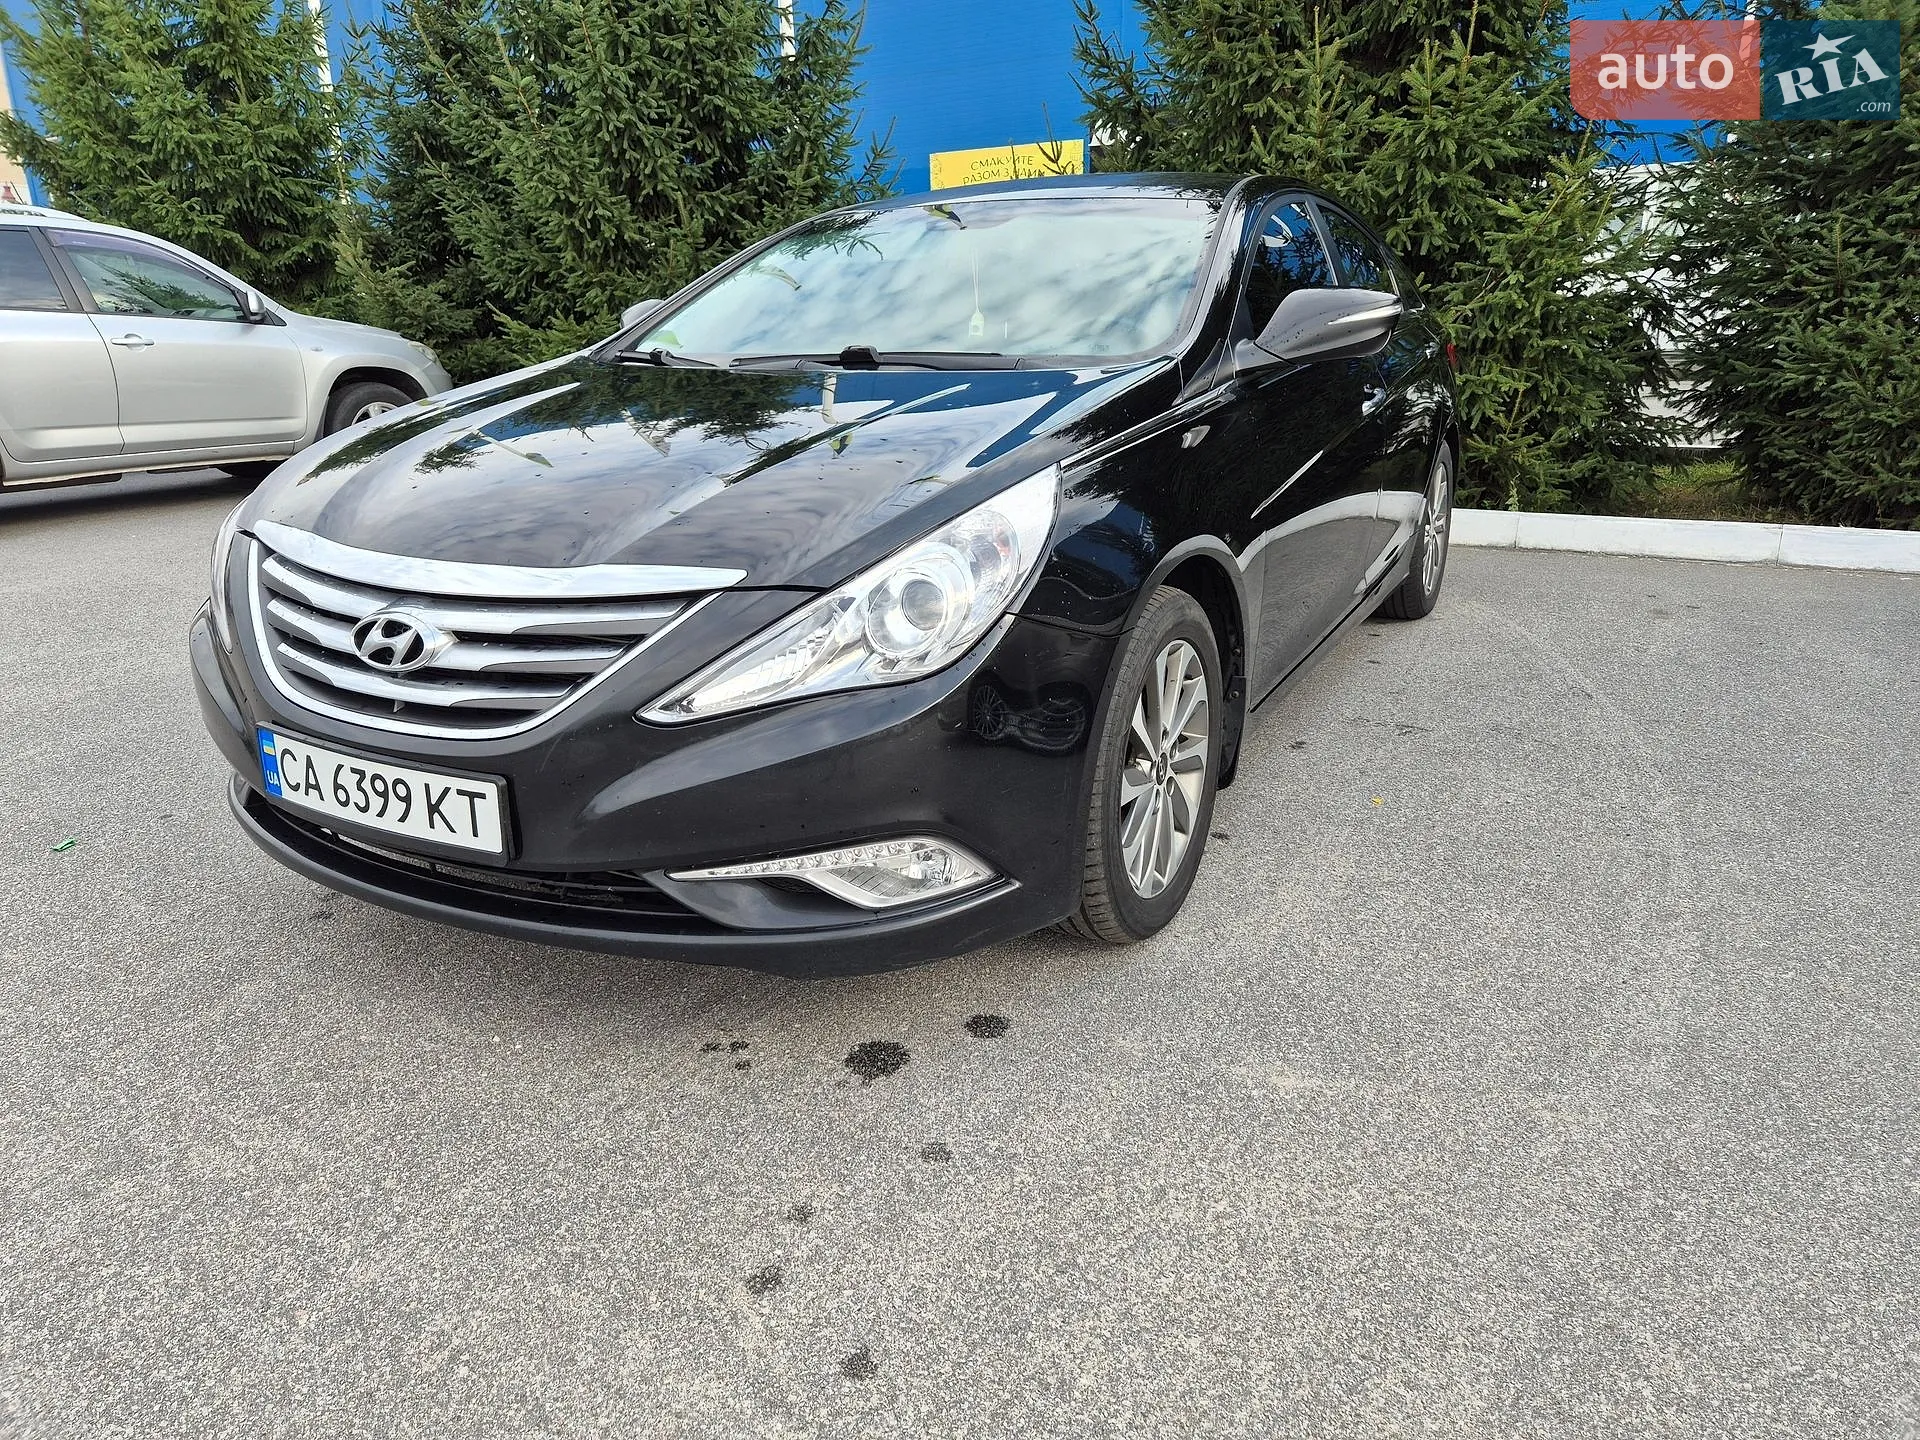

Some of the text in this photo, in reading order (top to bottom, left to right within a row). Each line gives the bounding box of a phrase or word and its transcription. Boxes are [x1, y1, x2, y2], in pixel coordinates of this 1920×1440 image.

[963, 169, 1001, 185] РАЗОМ
[266, 771, 281, 787] UA
[280, 748, 487, 838] CA 6399 KT
